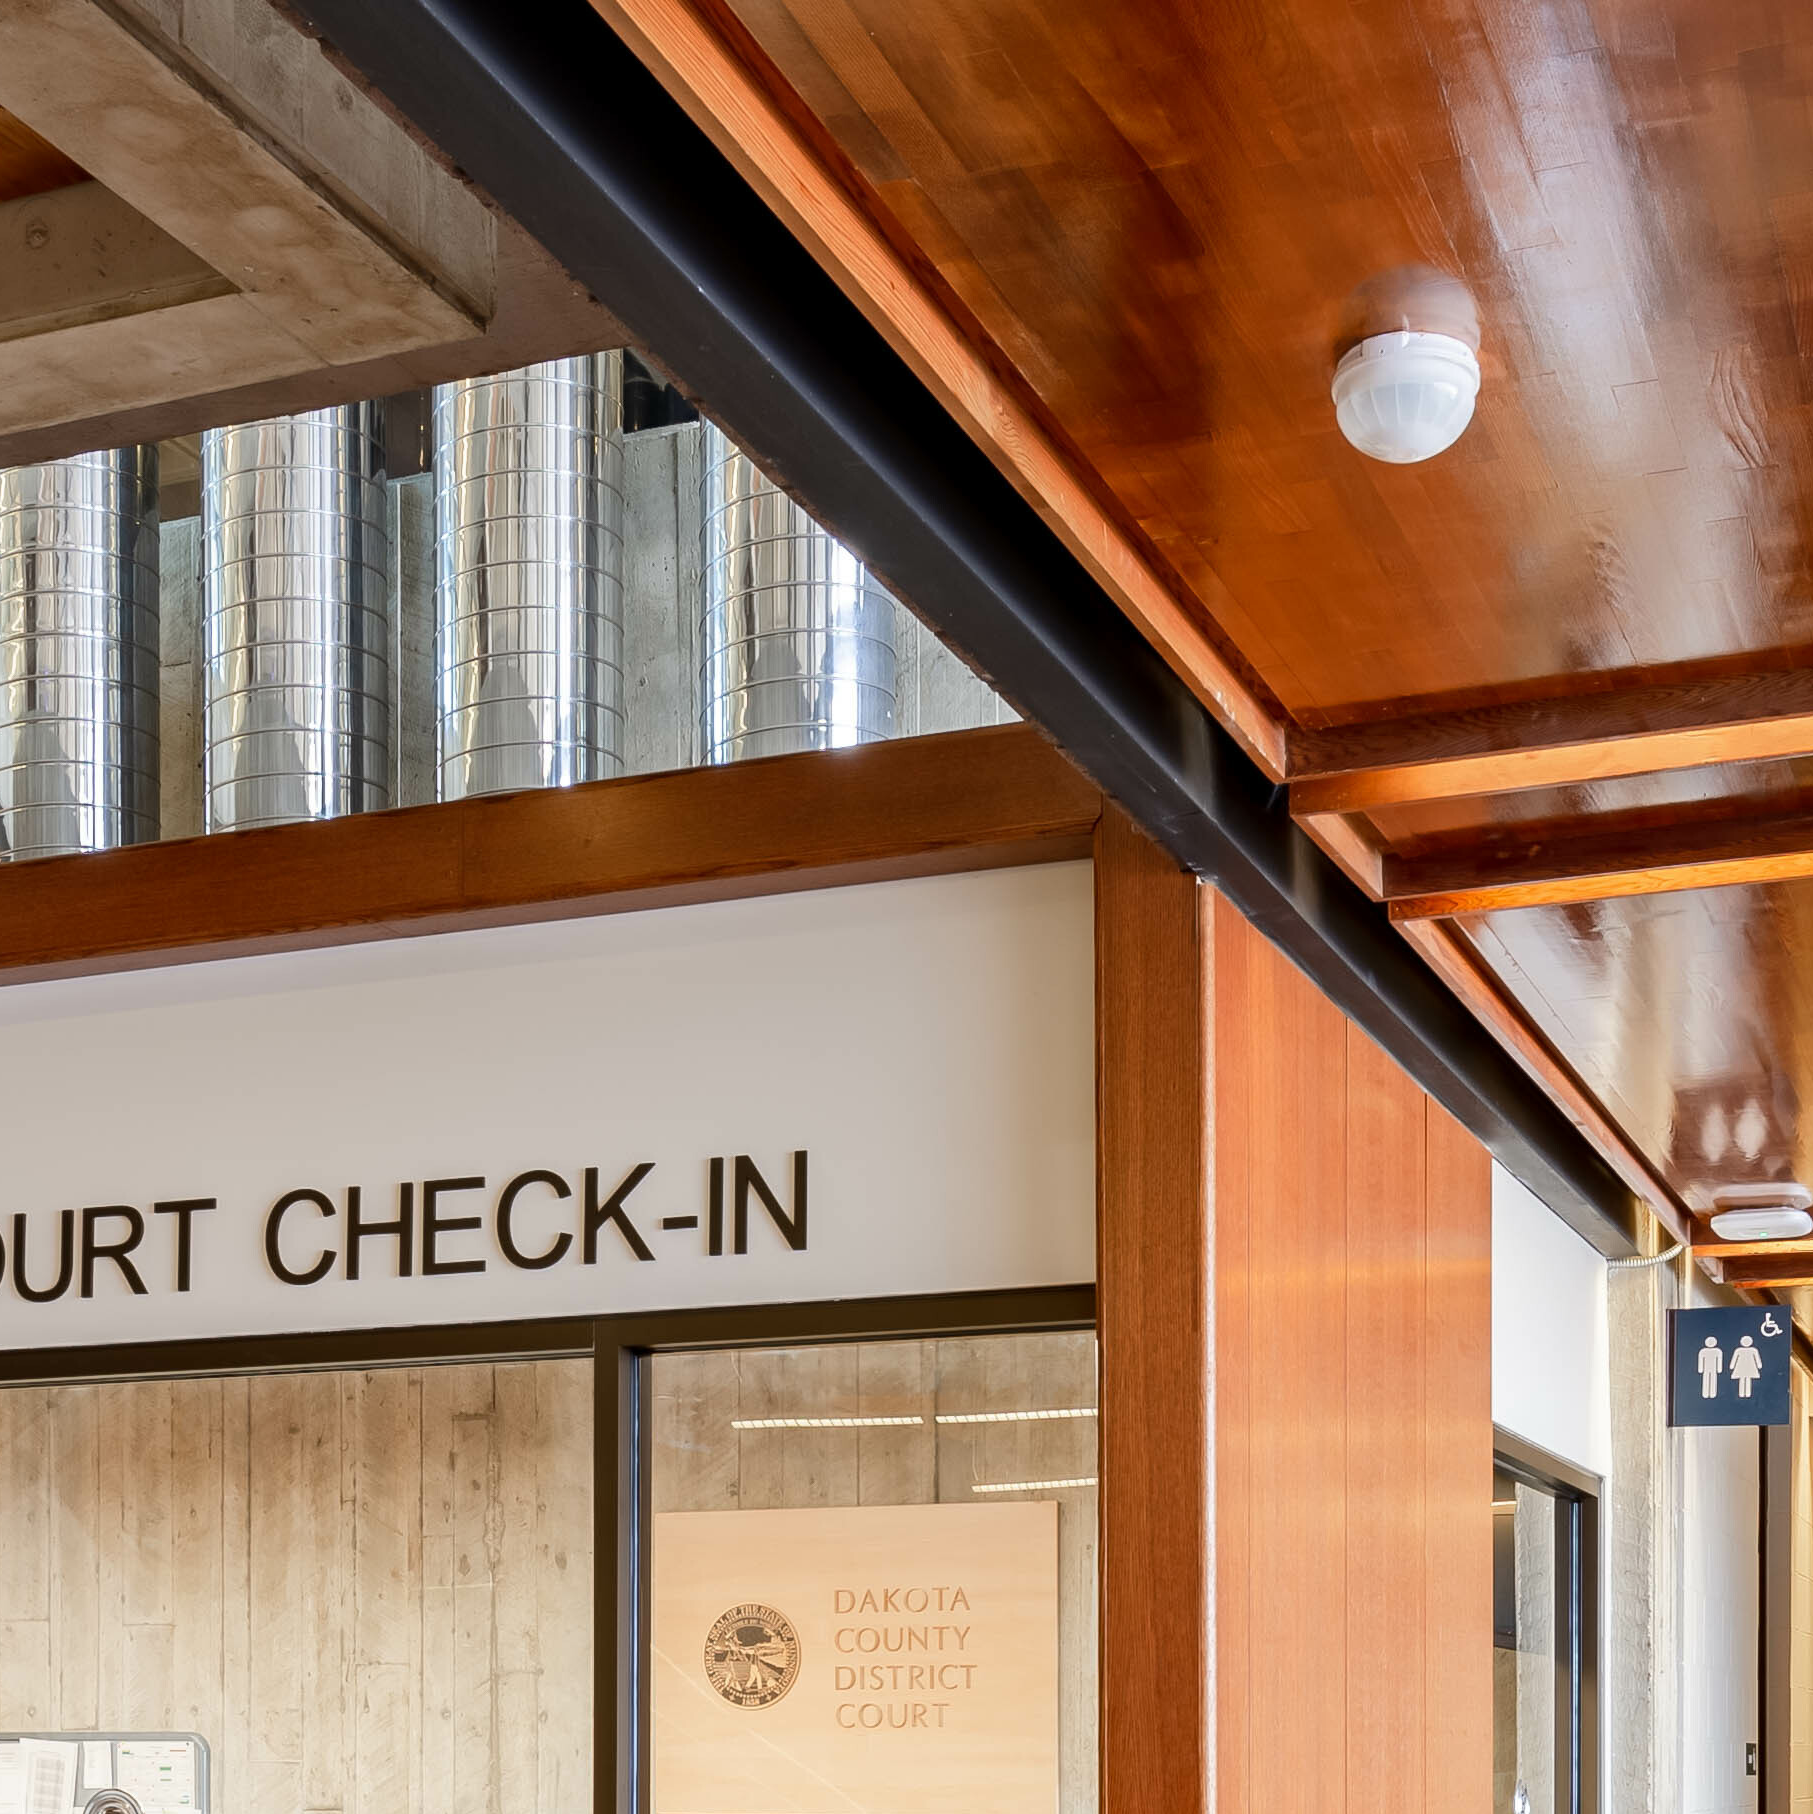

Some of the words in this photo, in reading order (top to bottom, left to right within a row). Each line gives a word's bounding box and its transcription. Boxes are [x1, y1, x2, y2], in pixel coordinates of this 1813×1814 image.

[265, 1150, 808, 1286] CHECK-IN
[834, 1586, 971, 1613] DAKOTA
[835, 1626, 971, 1652] COUNTY
[835, 1664, 977, 1690] DISTRICT
[836, 1703, 950, 1728] COURT
